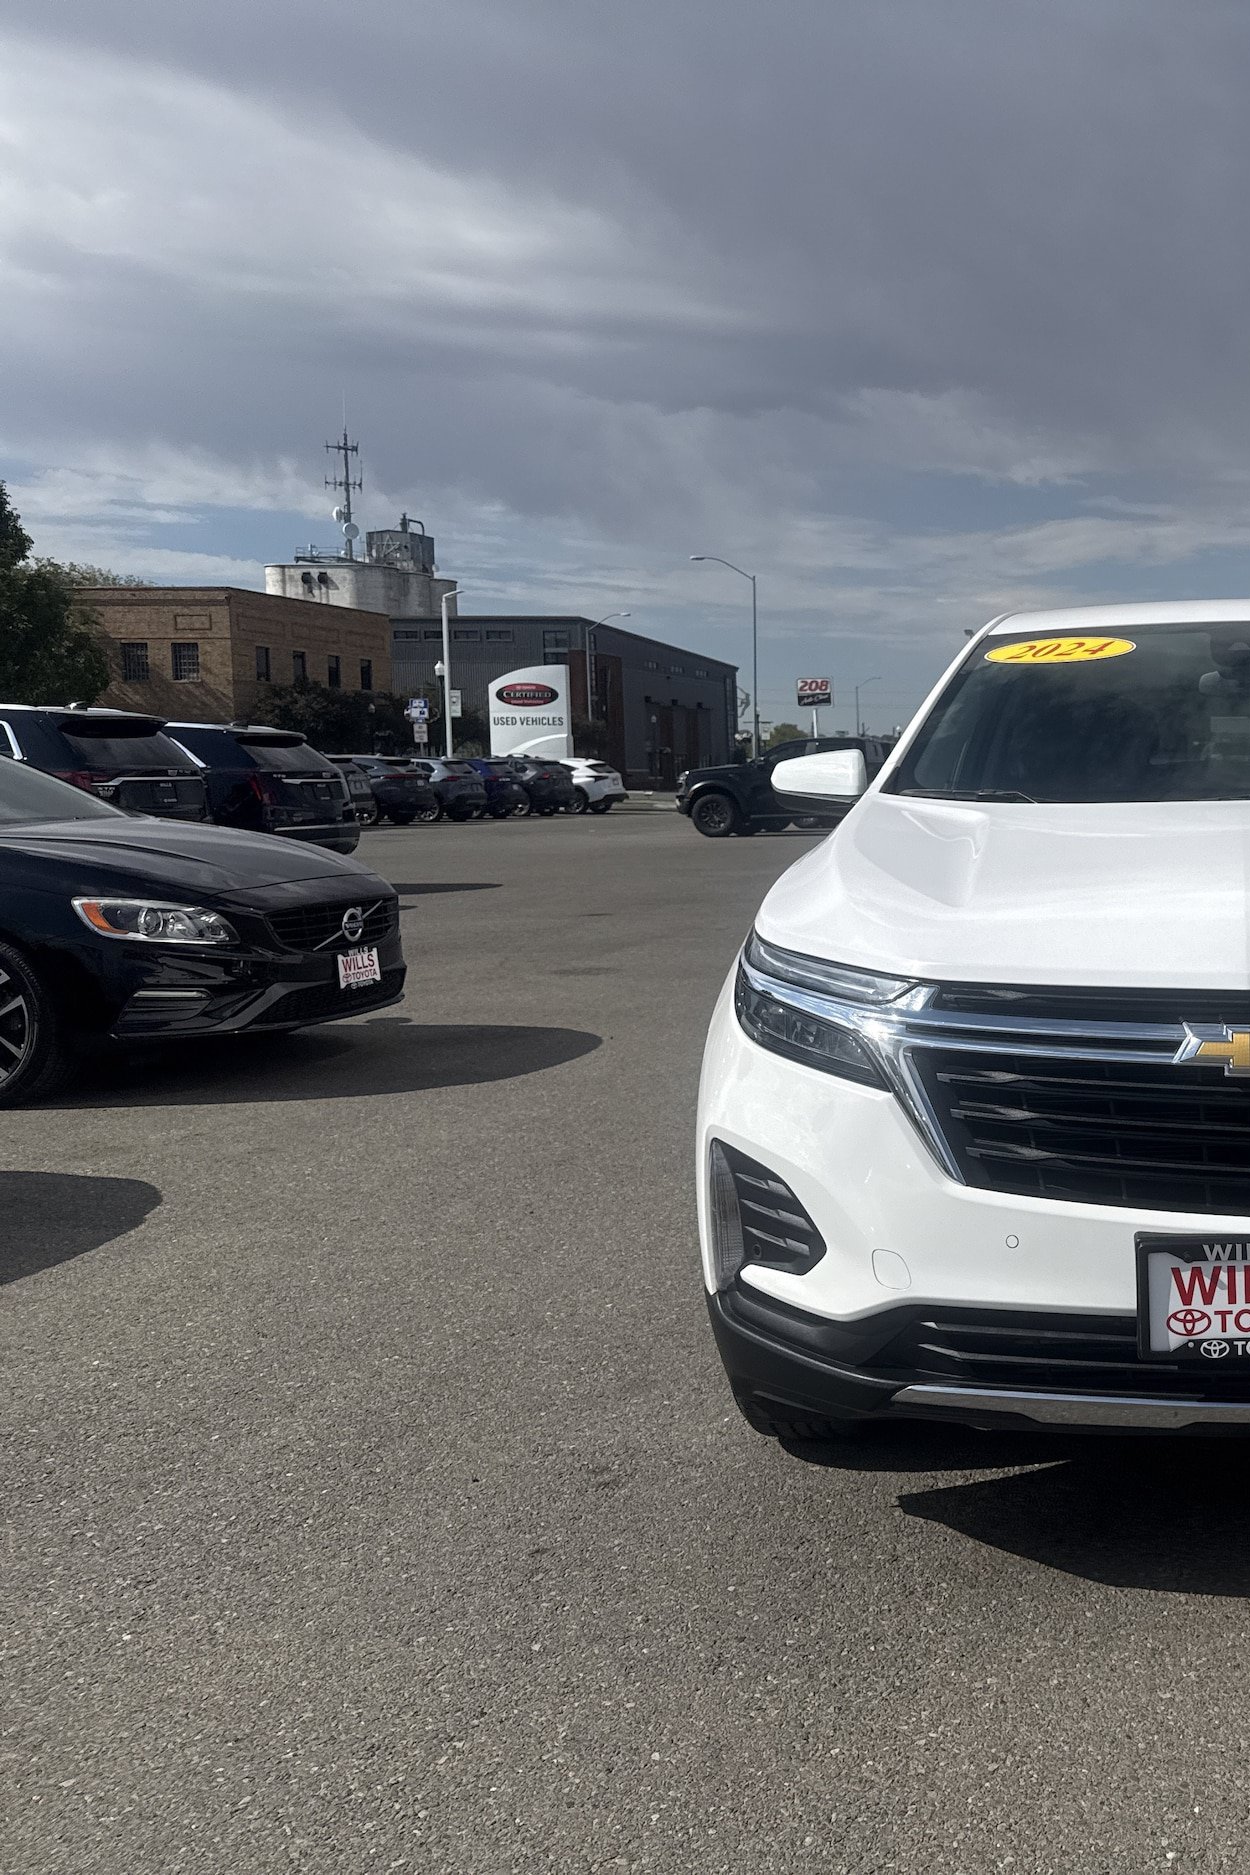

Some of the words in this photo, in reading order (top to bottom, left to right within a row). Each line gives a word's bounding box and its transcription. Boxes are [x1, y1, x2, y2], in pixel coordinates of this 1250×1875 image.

[1006, 640, 1115, 660] 2024
[799, 680, 829, 692] 208
[493, 716, 517, 726] USED
[519, 716, 564, 726] VEHICLES
[341, 954, 375, 973] WILLS
[352, 968, 378, 980] TOYOTA
